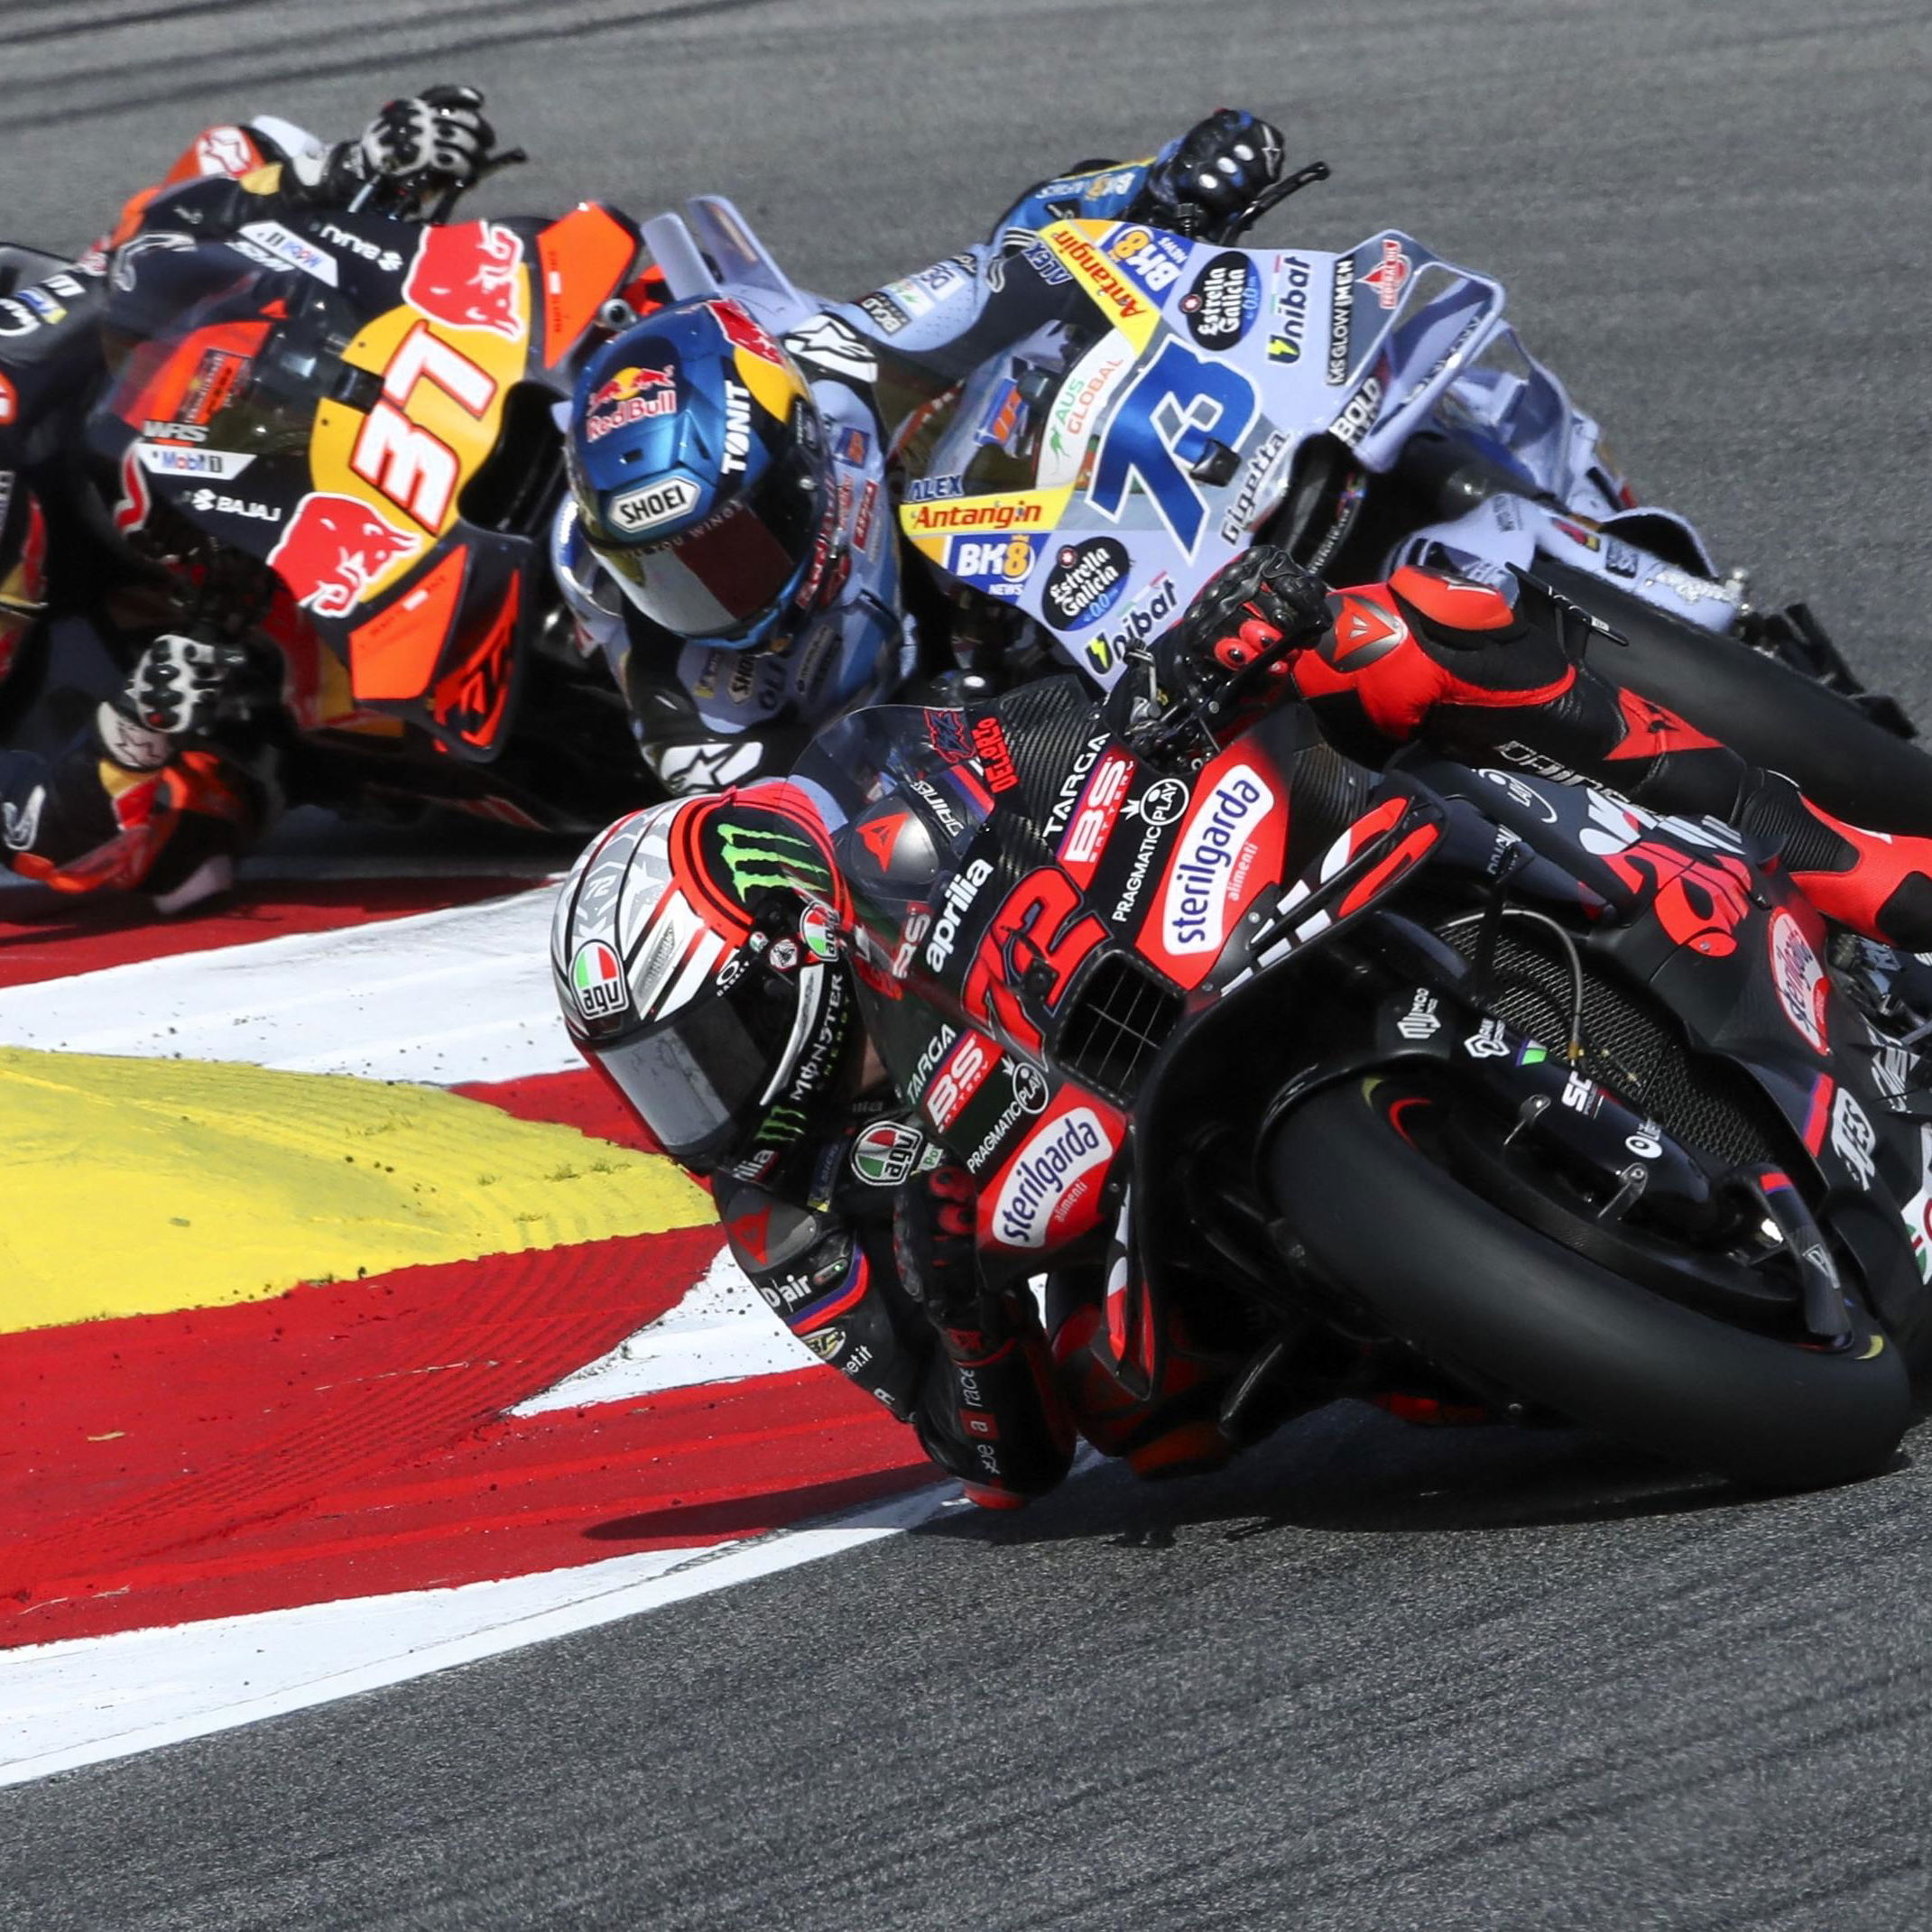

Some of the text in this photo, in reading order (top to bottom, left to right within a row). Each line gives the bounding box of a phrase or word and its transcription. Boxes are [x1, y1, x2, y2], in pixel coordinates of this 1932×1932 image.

[1021, 239, 1074, 286] ALEX
[1054, 229, 1147, 319] Antangin
[1112, 228, 1183, 293] BK8
[1158, 236, 1188, 264] NEWS
[1197, 266, 1227, 337] Estrella
[1219, 268, 1246, 334] Galicia
[1266, 255, 1312, 365] Unibat
[348, 318, 499, 539] 37
[587, 390, 677, 443] Red Bull
[1054, 378, 1086, 426] AUS
[1067, 359, 1123, 434] GLOBAL
[1328, 375, 1383, 442] BOLD
[161, 450, 207, 471] Mobil
[1085, 333, 1263, 567] 73
[215, 495, 282, 522] BAJAJ
[619, 485, 687, 524] SHOEI
[909, 473, 965, 503] ALEX
[913, 499, 1043, 530] Antangin
[1221, 430, 1289, 546] Gigetta
[956, 541, 1035, 582] BK8
[988, 583, 1025, 596] NEWS
[1049, 547, 1111, 605] Estrella
[1061, 565, 1119, 617] Galicia
[1084, 578, 1178, 677] Unibat
[1041, 731, 1112, 838] TARGA
[1063, 755, 1128, 863] BS
[1151, 782, 1179, 821] PLAY
[1111, 825, 1163, 923] PRAGMATIC
[1172, 778, 1260, 944] sterilgarda
[1226, 841, 1260, 902] alimenti
[925, 856, 994, 974] aprilia
[581, 979, 626, 1012] agv
[962, 865, 1115, 1072] 72
[790, 973, 844, 1102] MONSTER
[906, 1022, 957, 1105] TARGA
[927, 1032, 984, 1127] BS
[1018, 1068, 1044, 1107] PLAY
[884, 1133, 914, 1178] agv
[966, 1101, 1022, 1175] PRAGMATIC
[1003, 1116, 1101, 1243] sterilgarda
[1054, 1181, 1089, 1224] alimenti
[969, 1419, 989, 1433] a
